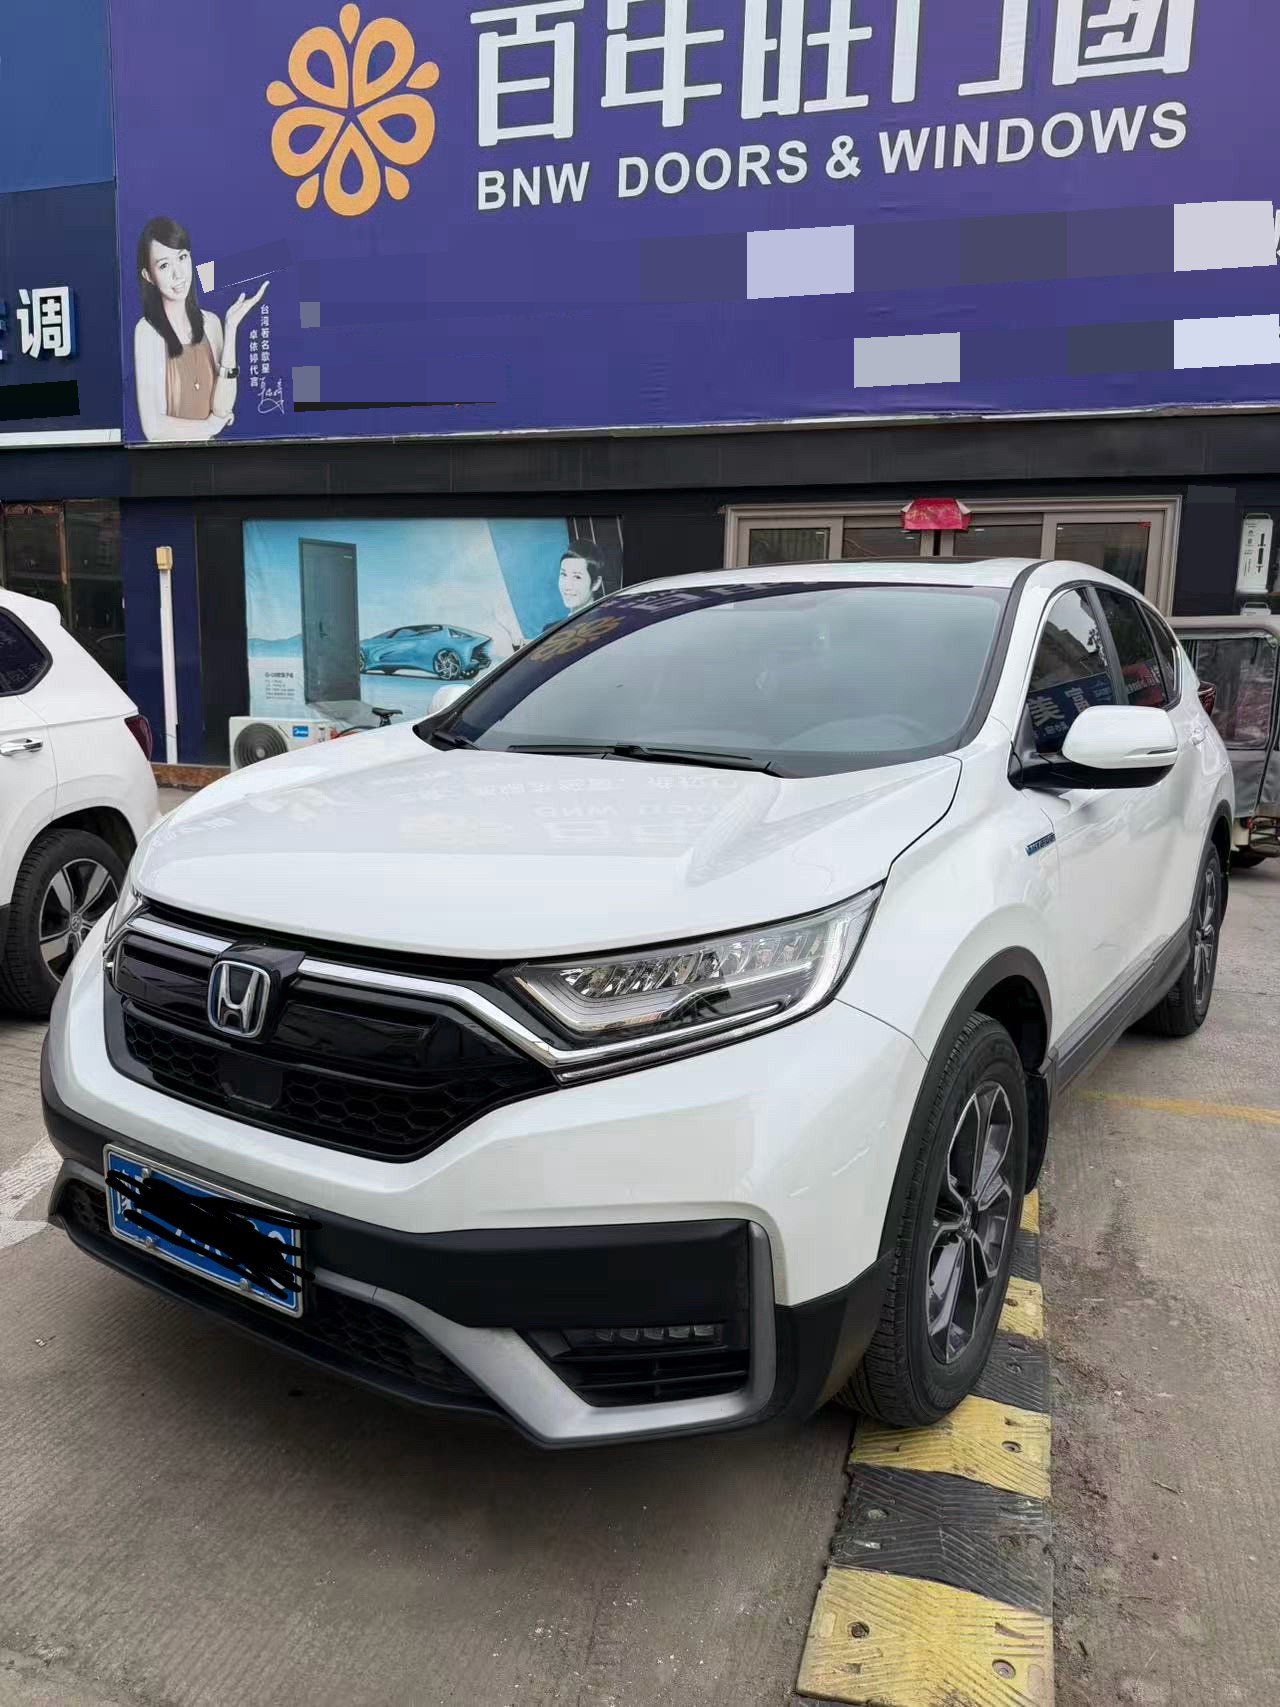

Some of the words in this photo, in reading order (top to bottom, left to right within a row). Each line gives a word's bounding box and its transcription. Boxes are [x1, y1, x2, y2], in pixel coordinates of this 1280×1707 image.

[477, 161, 590, 210] BNW
[617, 140, 808, 198] DOORS
[825, 134, 861, 179] &
[877, 101, 1188, 174] WINDOWS
[0, 286, 72, 359] 调
